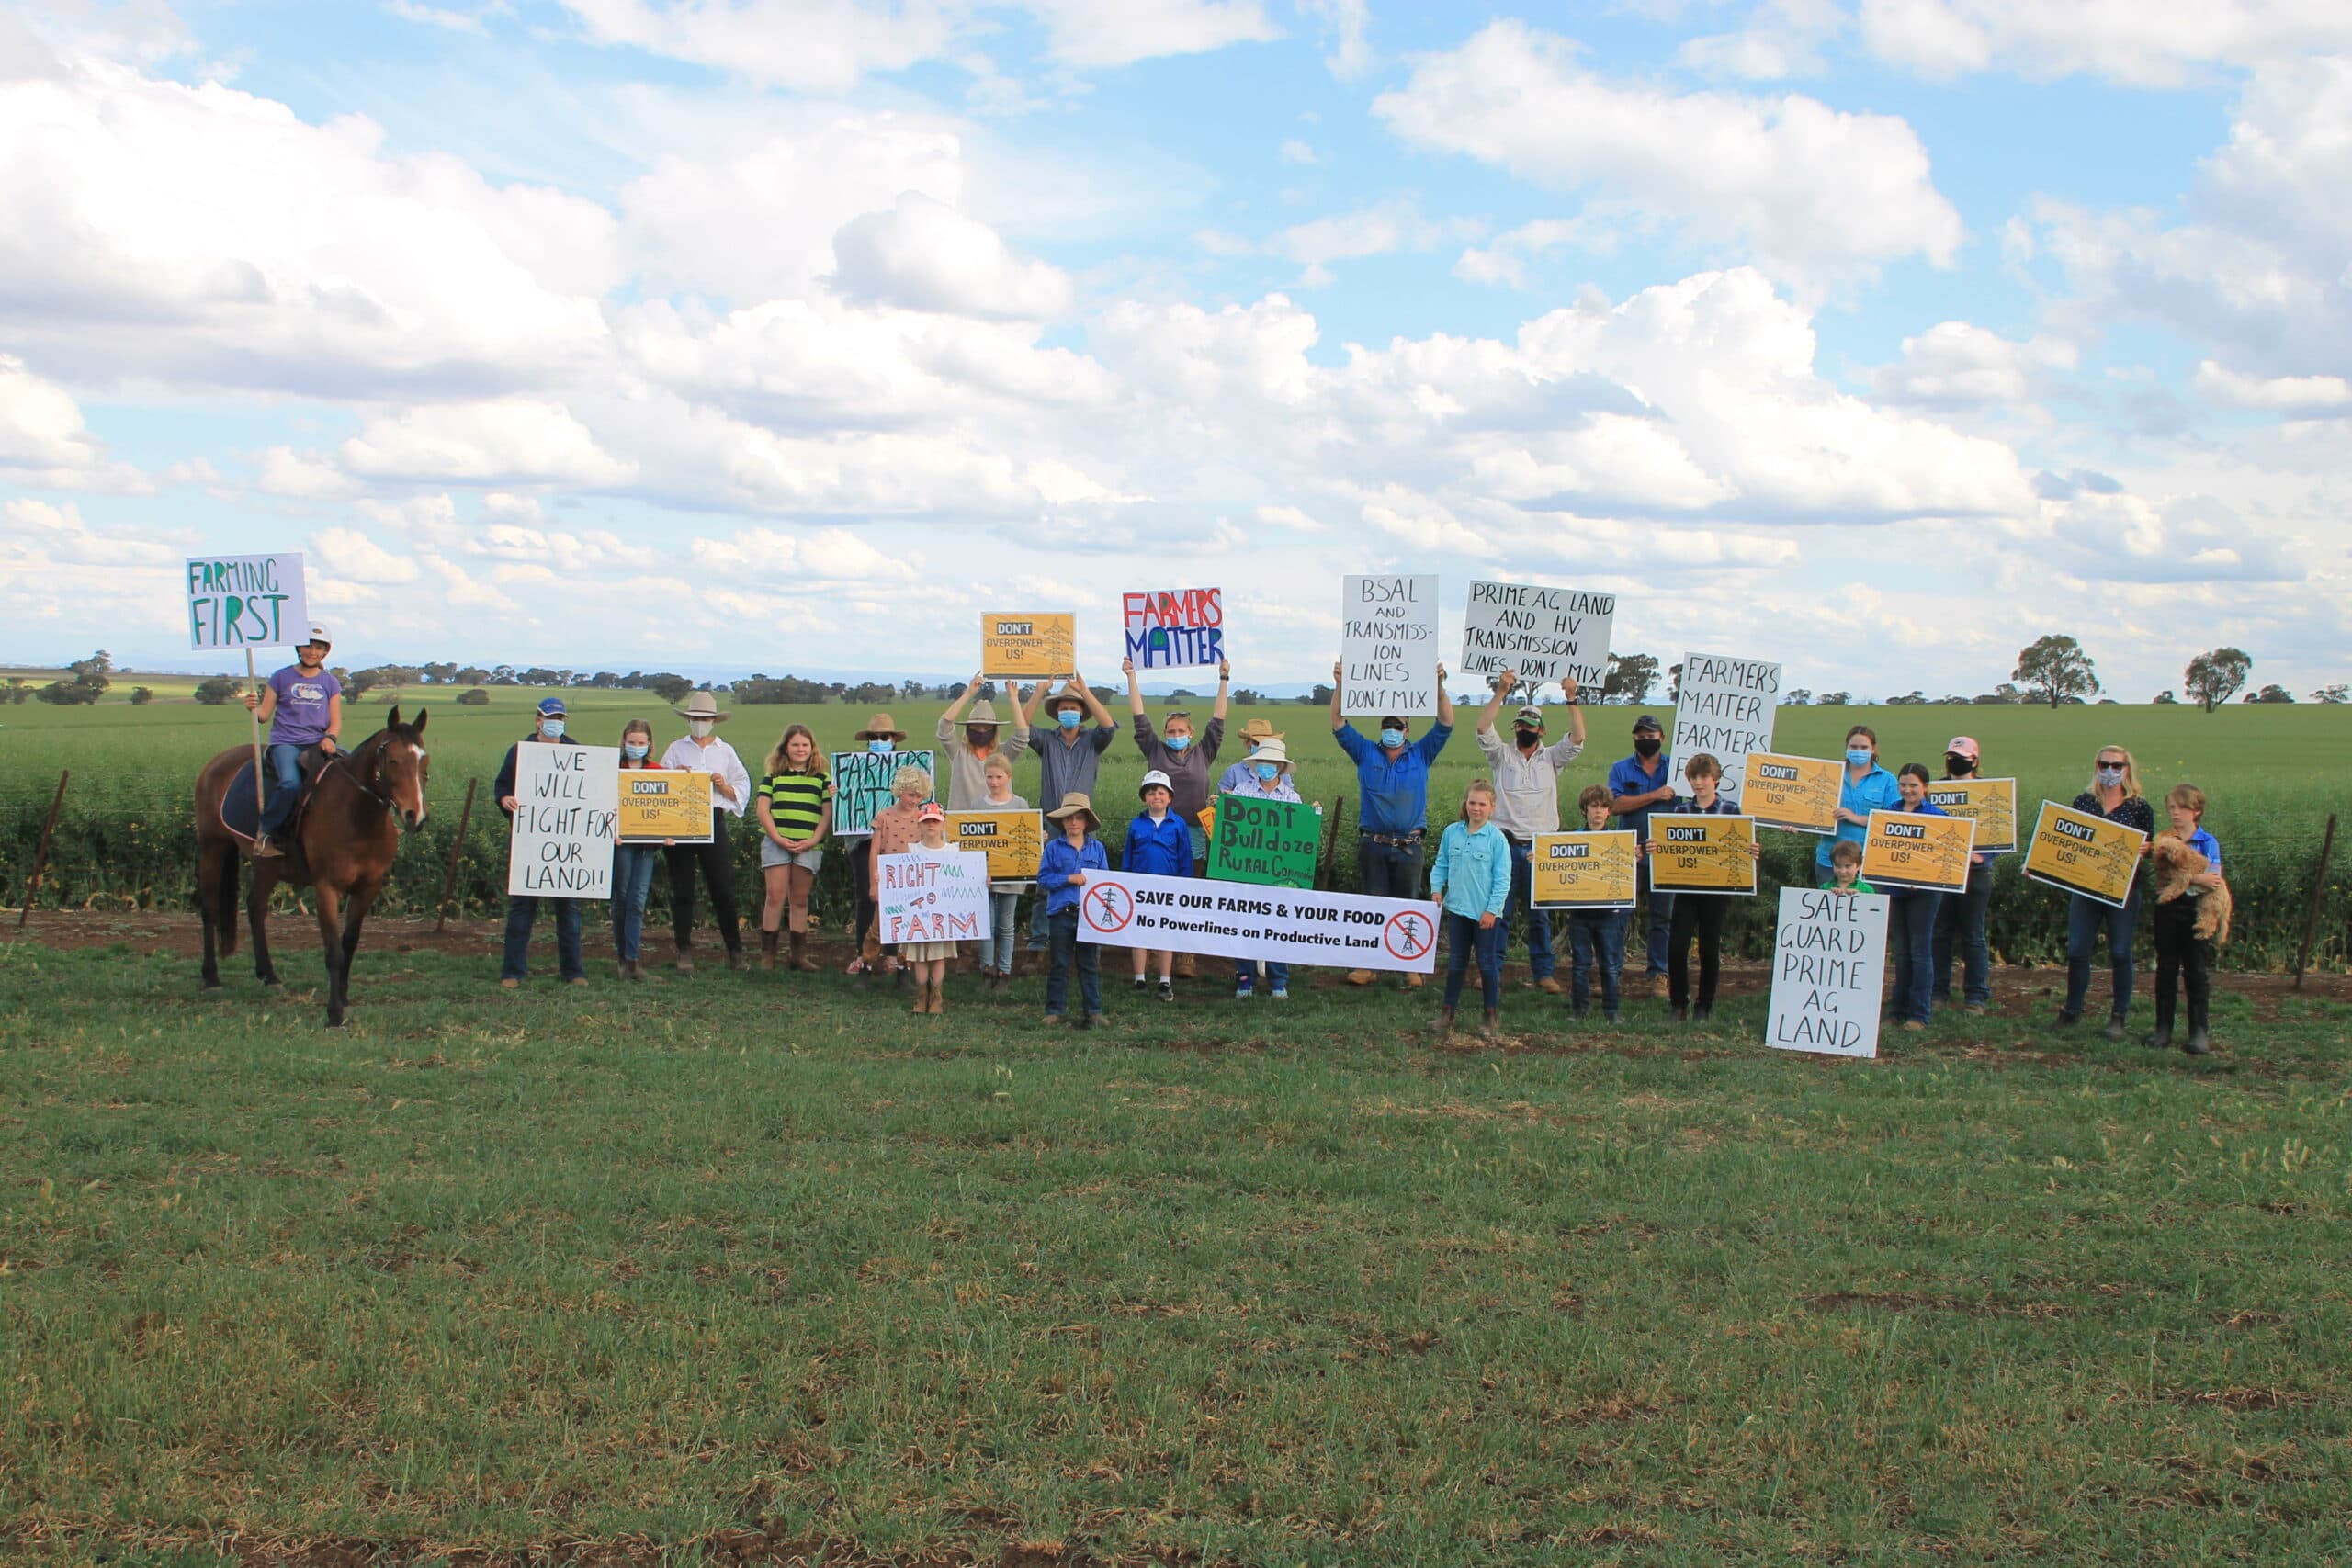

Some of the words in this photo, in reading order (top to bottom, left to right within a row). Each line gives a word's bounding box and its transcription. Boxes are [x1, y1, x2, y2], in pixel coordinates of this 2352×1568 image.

[189, 558, 278, 594] FARMING
[1362, 579, 1418, 603] BSAL
[1473, 583, 1529, 607] PRIME
[1532, 590, 1561, 611] AG
[1570, 593, 1616, 615] LAND
[1123, 588, 1223, 627] FARMERS
[1375, 606, 1406, 618] AND
[193, 594, 289, 645] FIRST
[998, 624, 1031, 634] DON'T
[1345, 620, 1433, 640] TRANSMISS-
[1495, 609, 1536, 631] AND
[1554, 615, 1582, 635] HV
[986, 638, 1043, 647] OVERPOWER
[1125, 626, 1225, 668] MATTER
[1465, 626, 1578, 657] TRANSMISSION
[1006, 649, 1023, 659] US!
[1374, 645, 1402, 660] ION
[1351, 663, 1410, 682] LINES
[1464, 653, 1509, 673] LINES
[1567, 663, 1602, 684] MIX
[1688, 657, 1779, 694] FARMERS
[1391, 690, 1428, 709] MIX
[1680, 690, 1762, 723] MATTER
[1676, 721, 1769, 754] FARMERS
[553, 750, 587, 772] WE
[1761, 765, 1797, 780] DON'T
[535, 773, 586, 799] WILL
[633, 782, 667, 793] DON'T
[1747, 779, 1806, 795] OVERPOWER
[622, 797, 679, 807] OVERPOWER
[1766, 793, 1785, 805] US!
[1930, 793, 1967, 805] DON'T
[517, 805, 581, 835] FIGHT
[585, 809, 614, 839] FOR
[641, 809, 661, 819] US!
[1223, 797, 1296, 829] Don't
[961, 823, 996, 835] DON'T
[1220, 821, 1314, 854] Bulldoze
[1668, 828, 1704, 840] DON'T
[1885, 824, 1924, 838] DON'T
[2055, 819, 2094, 840] DON'T
[541, 841, 582, 863] OUR
[1552, 844, 1588, 857] DON'T
[1656, 844, 1718, 855] OVERPOWER
[1871, 838, 1934, 853] OVERPOWER
[2040, 831, 2100, 859] OVERPOWER
[1538, 862, 1600, 872] OVERPOWER
[1678, 858, 1698, 868] US!
[1890, 852, 1911, 863] US!
[2056, 850, 2076, 865] US!
[526, 865, 604, 891] LAND!!
[886, 863, 941, 889] RIGHT
[1559, 874, 1578, 885] US!
[910, 892, 936, 908] TO
[1136, 890, 1175, 906] SAVE
[1179, 894, 1213, 909] OUR
[1217, 897, 1272, 916] FARMS
[1276, 904, 1288, 918] &
[1295, 906, 1338, 922] YOUR
[1343, 910, 1385, 926] FOOD
[891, 911, 978, 942] FARM
[1136, 915, 1156, 928] No
[1159, 917, 1238, 937] Powerlines
[1242, 930, 1260, 939] on
[1264, 928, 1341, 946] Productive
[1345, 935, 1379, 949] Land
[1780, 923, 1865, 953] GUARD
[1783, 953, 1866, 990] PRIME
[1803, 989, 1838, 1014] AG
[1778, 1013, 1861, 1048] LAND
